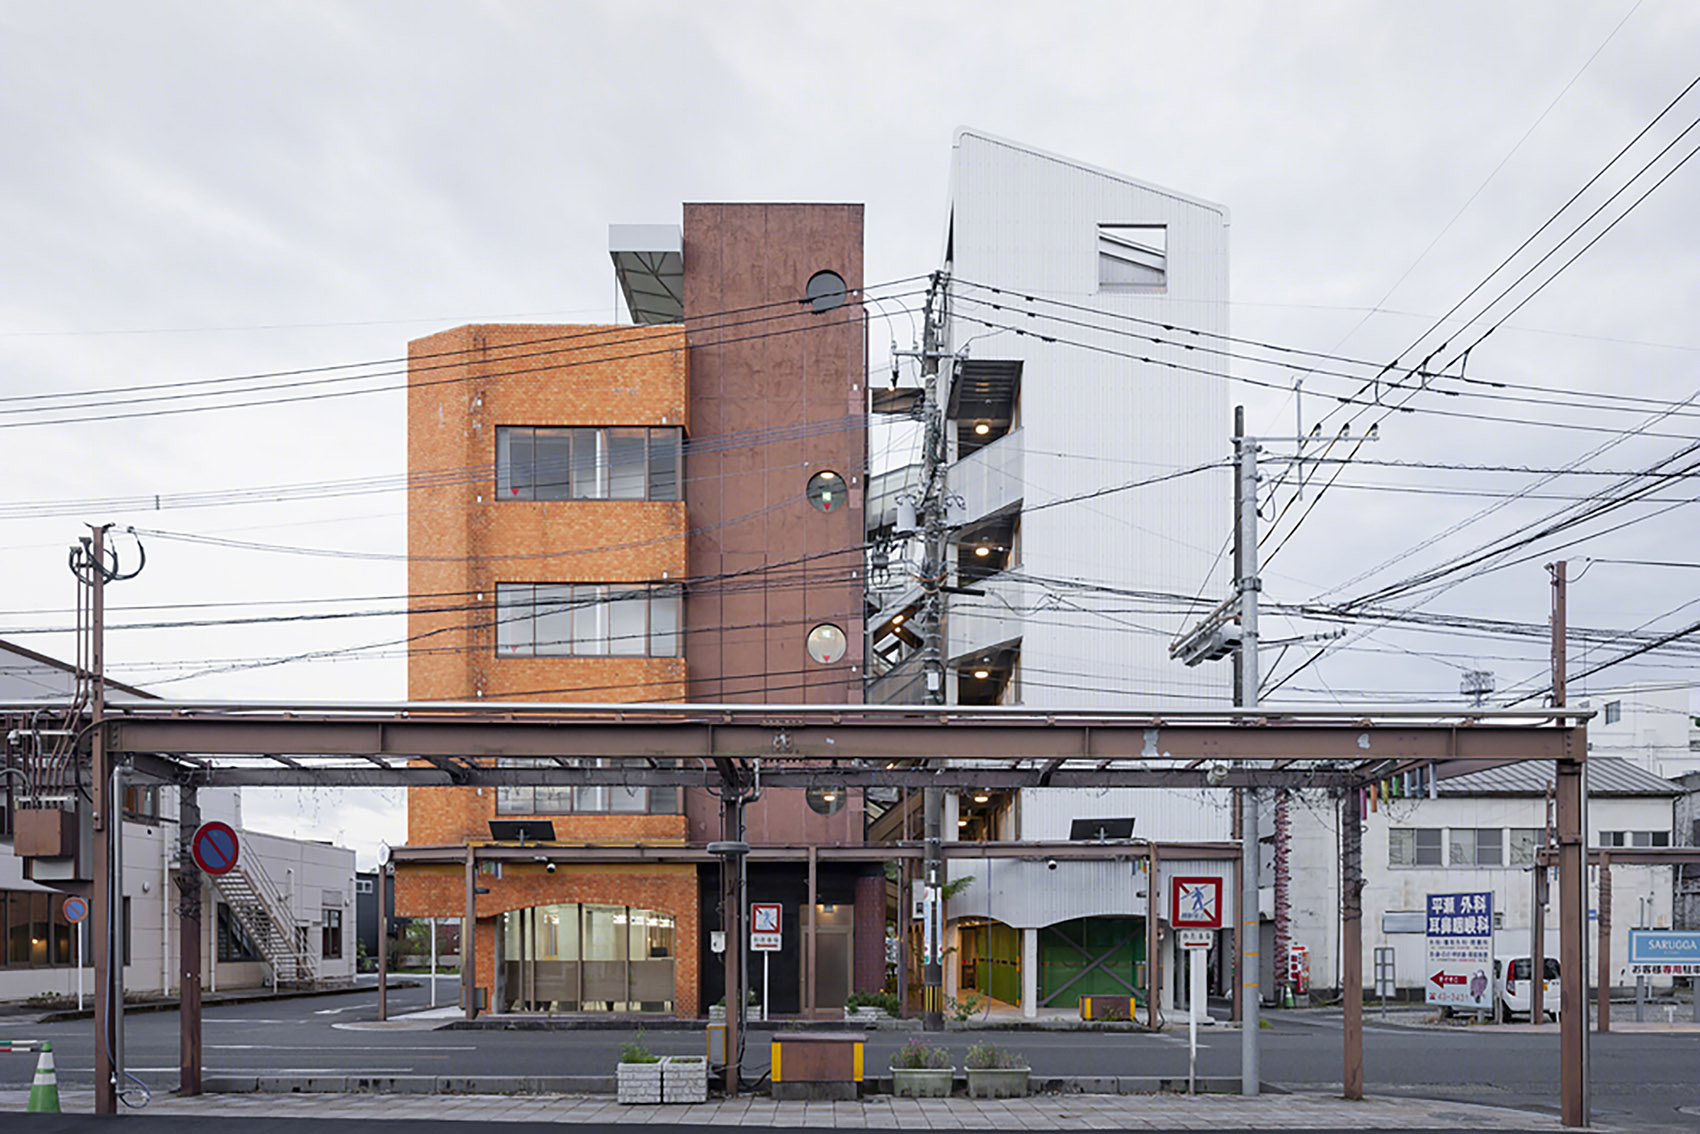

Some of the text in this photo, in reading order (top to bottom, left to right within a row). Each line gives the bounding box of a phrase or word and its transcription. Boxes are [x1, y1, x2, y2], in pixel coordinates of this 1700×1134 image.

[1461, 895, 1486, 914] 外科
[1429, 915, 1489, 934] 耳鼻咽喉科
